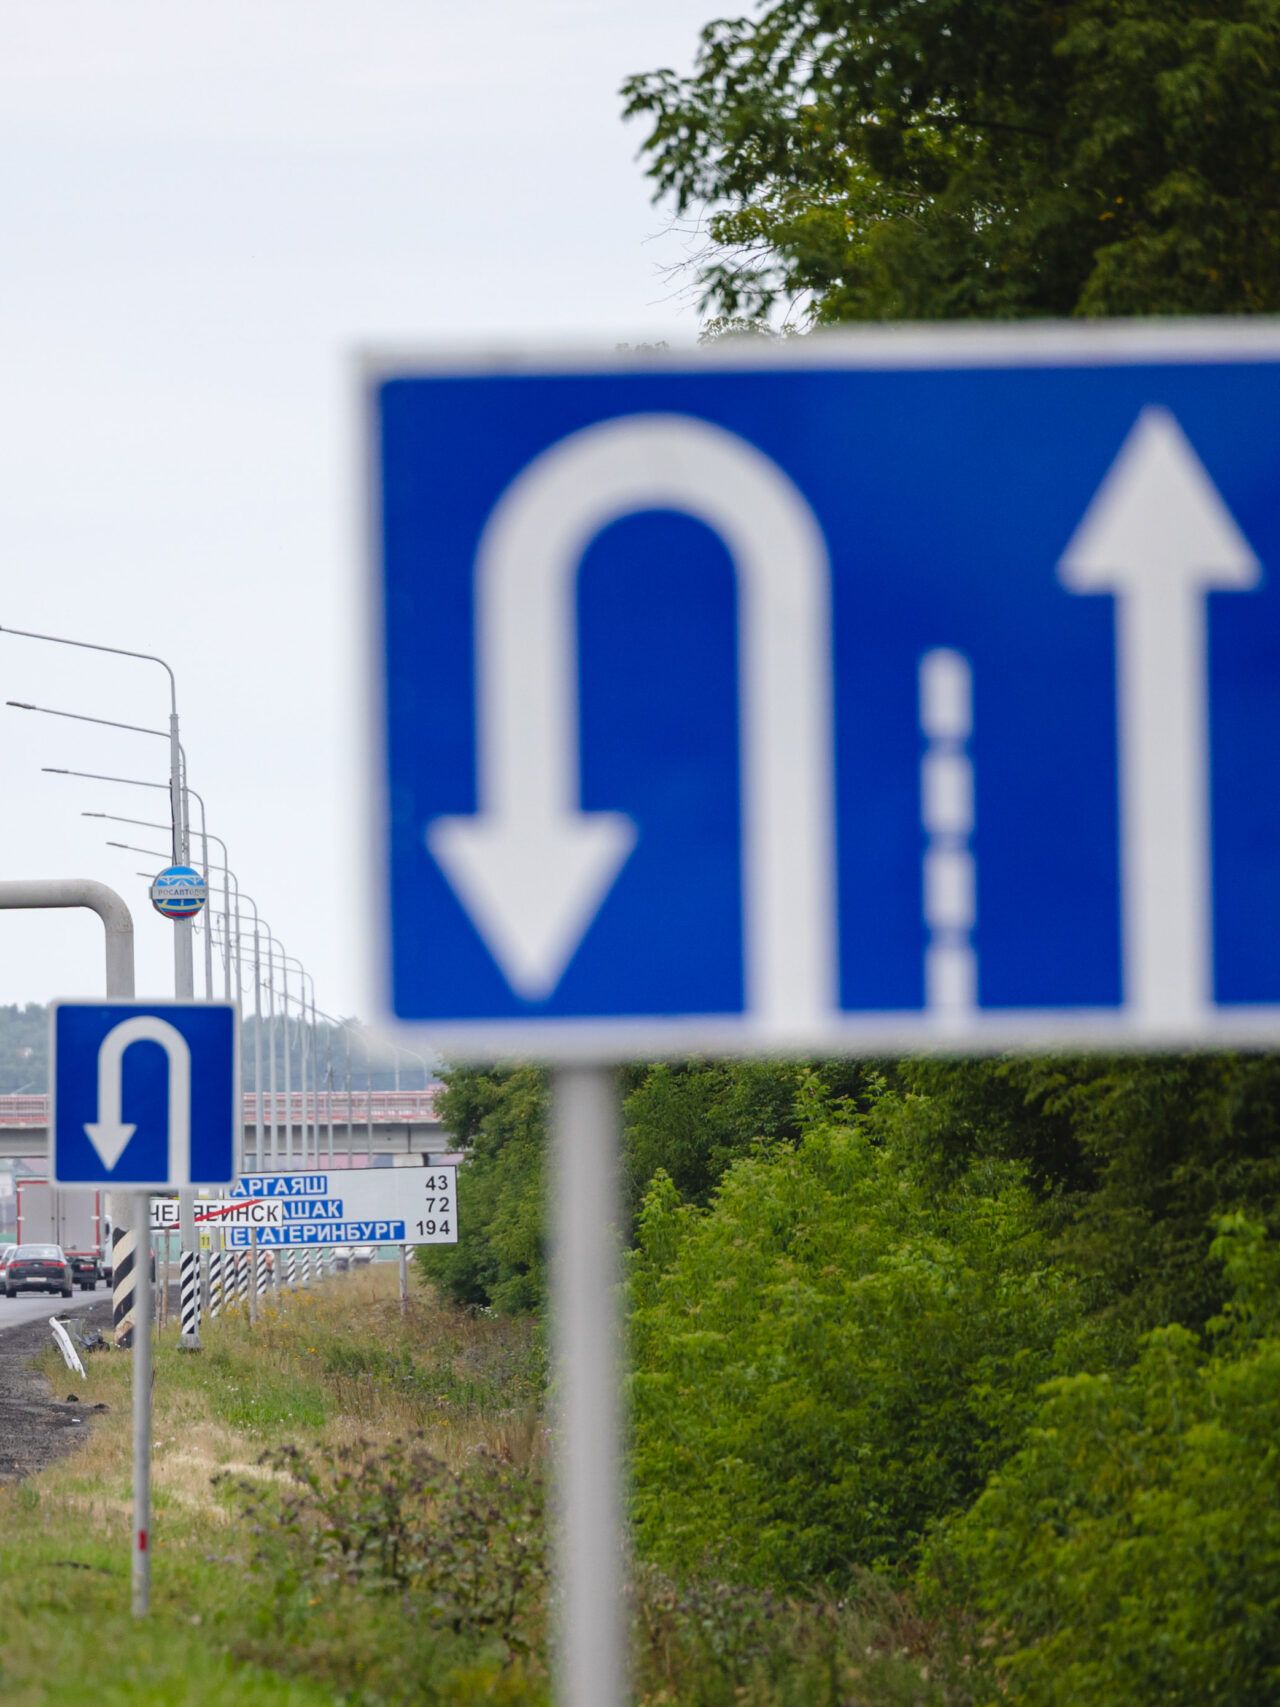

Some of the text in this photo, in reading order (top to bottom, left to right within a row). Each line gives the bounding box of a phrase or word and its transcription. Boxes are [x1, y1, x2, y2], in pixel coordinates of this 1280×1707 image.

[232, 1175, 448, 1197] АРГАЯШ 43
[426, 1197, 450, 1213] 72
[416, 1220, 451, 1235] 194
